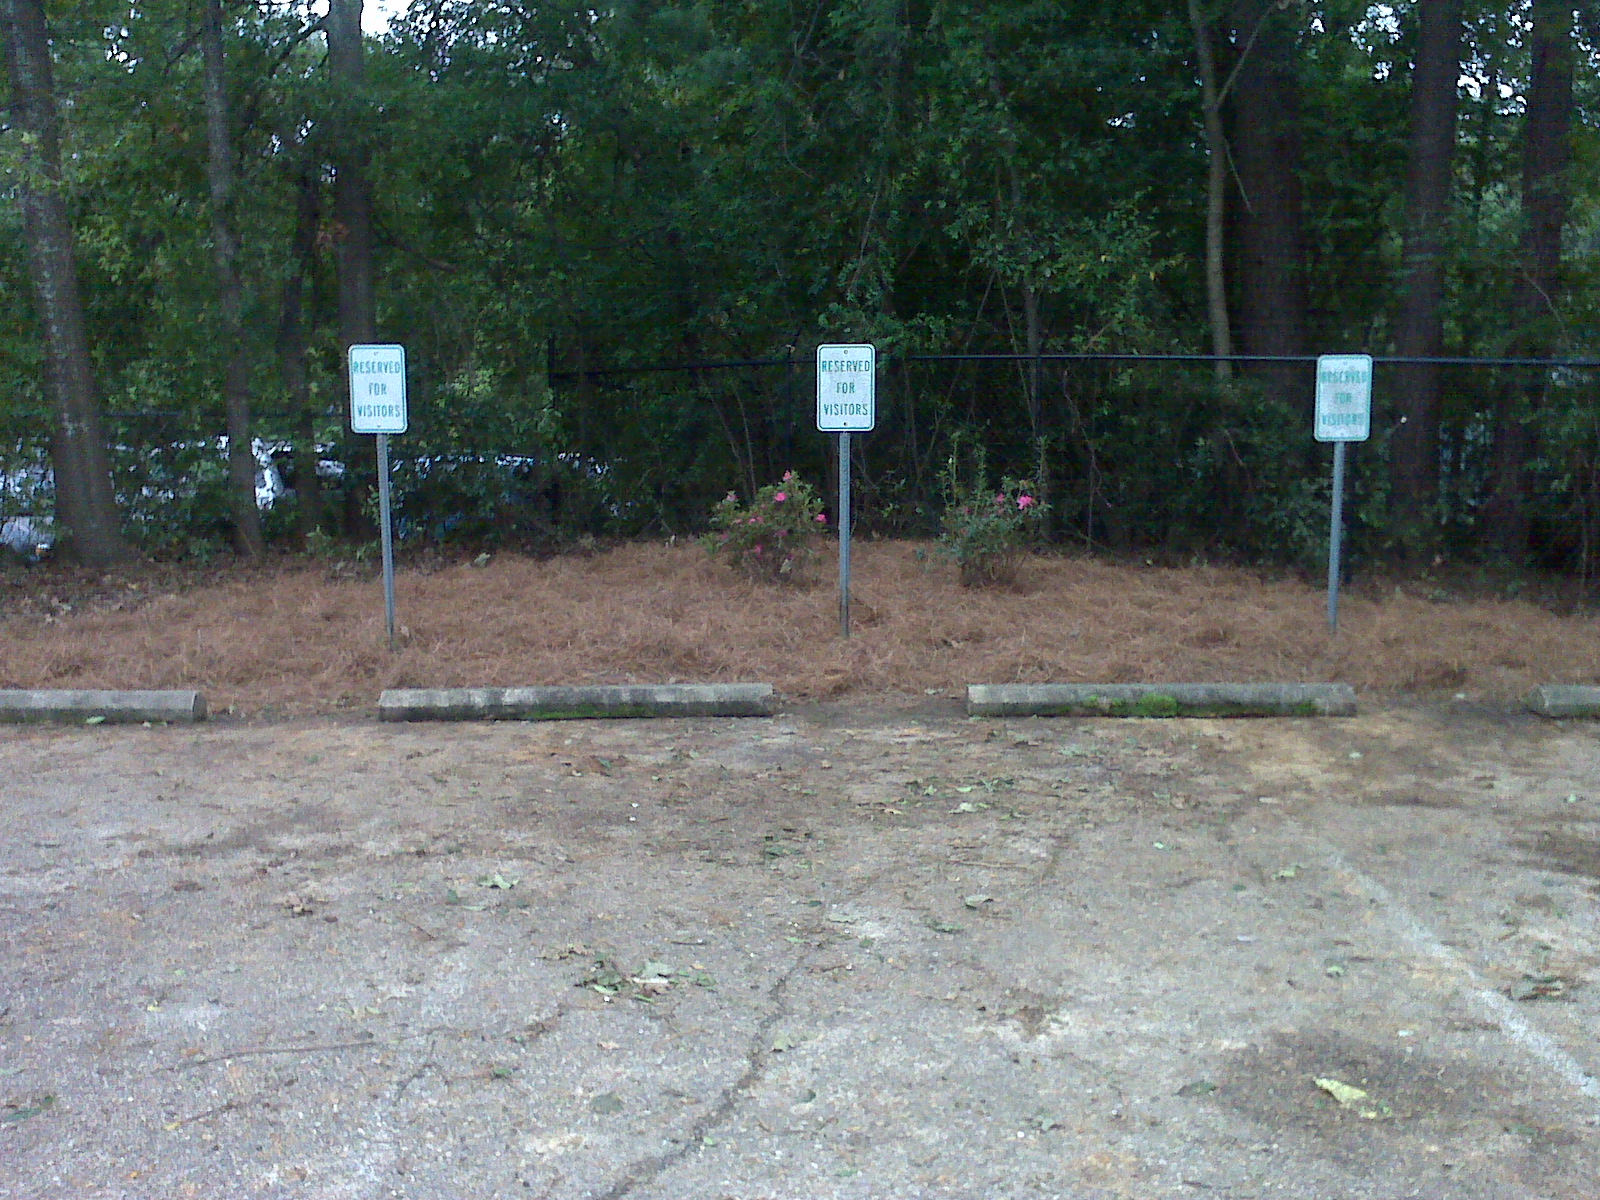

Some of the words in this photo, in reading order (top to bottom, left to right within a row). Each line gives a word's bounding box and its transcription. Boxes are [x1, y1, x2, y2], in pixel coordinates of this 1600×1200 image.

[353, 361, 401, 374] RESERVED
[822, 360, 870, 372] RESERVED
[368, 382, 387, 396] FOR
[836, 382, 856, 394] FOR
[357, 404, 401, 418] VISITORS
[823, 403, 868, 416] VISITORS
